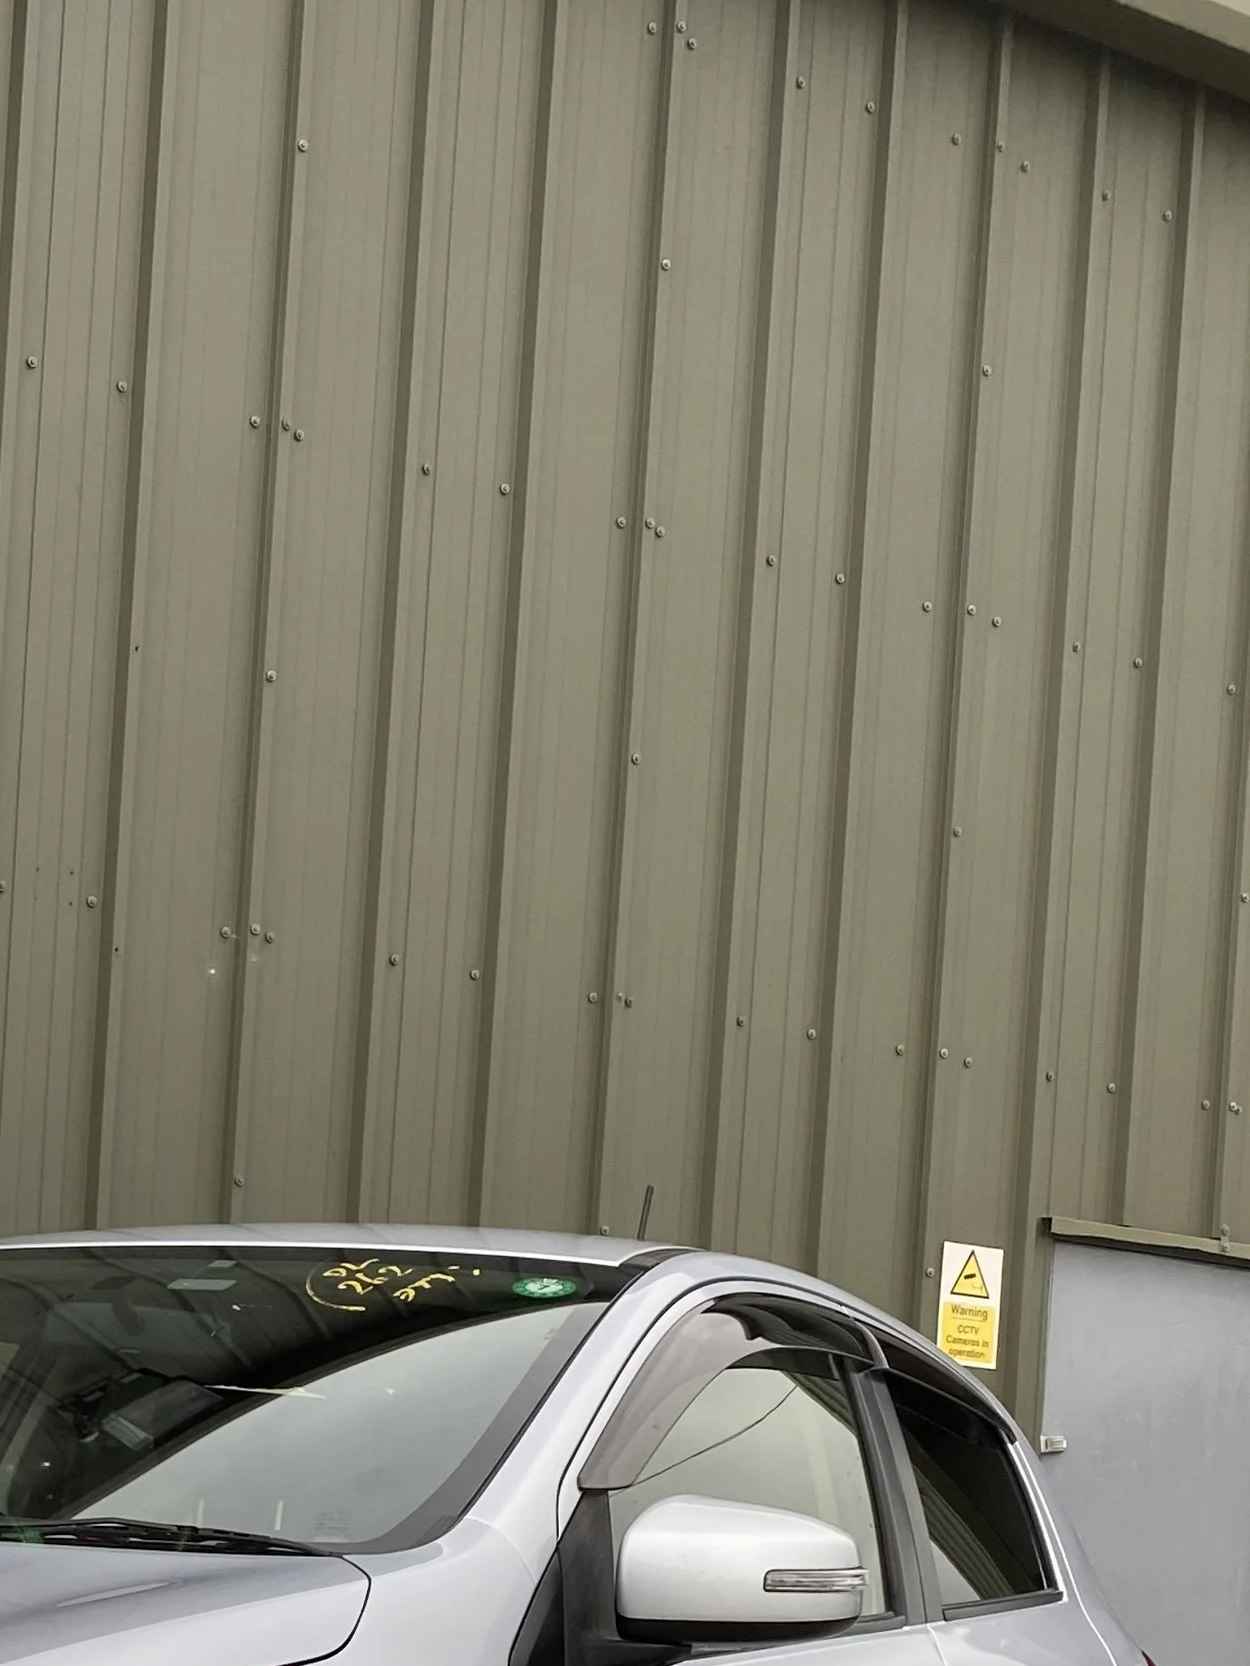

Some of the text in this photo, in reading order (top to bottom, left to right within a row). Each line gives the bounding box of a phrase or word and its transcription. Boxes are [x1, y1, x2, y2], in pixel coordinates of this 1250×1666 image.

[951, 1304, 988, 1320] Warning
[957, 1324, 979, 1335] CCTV
[946, 1335, 980, 1347] Cameras
